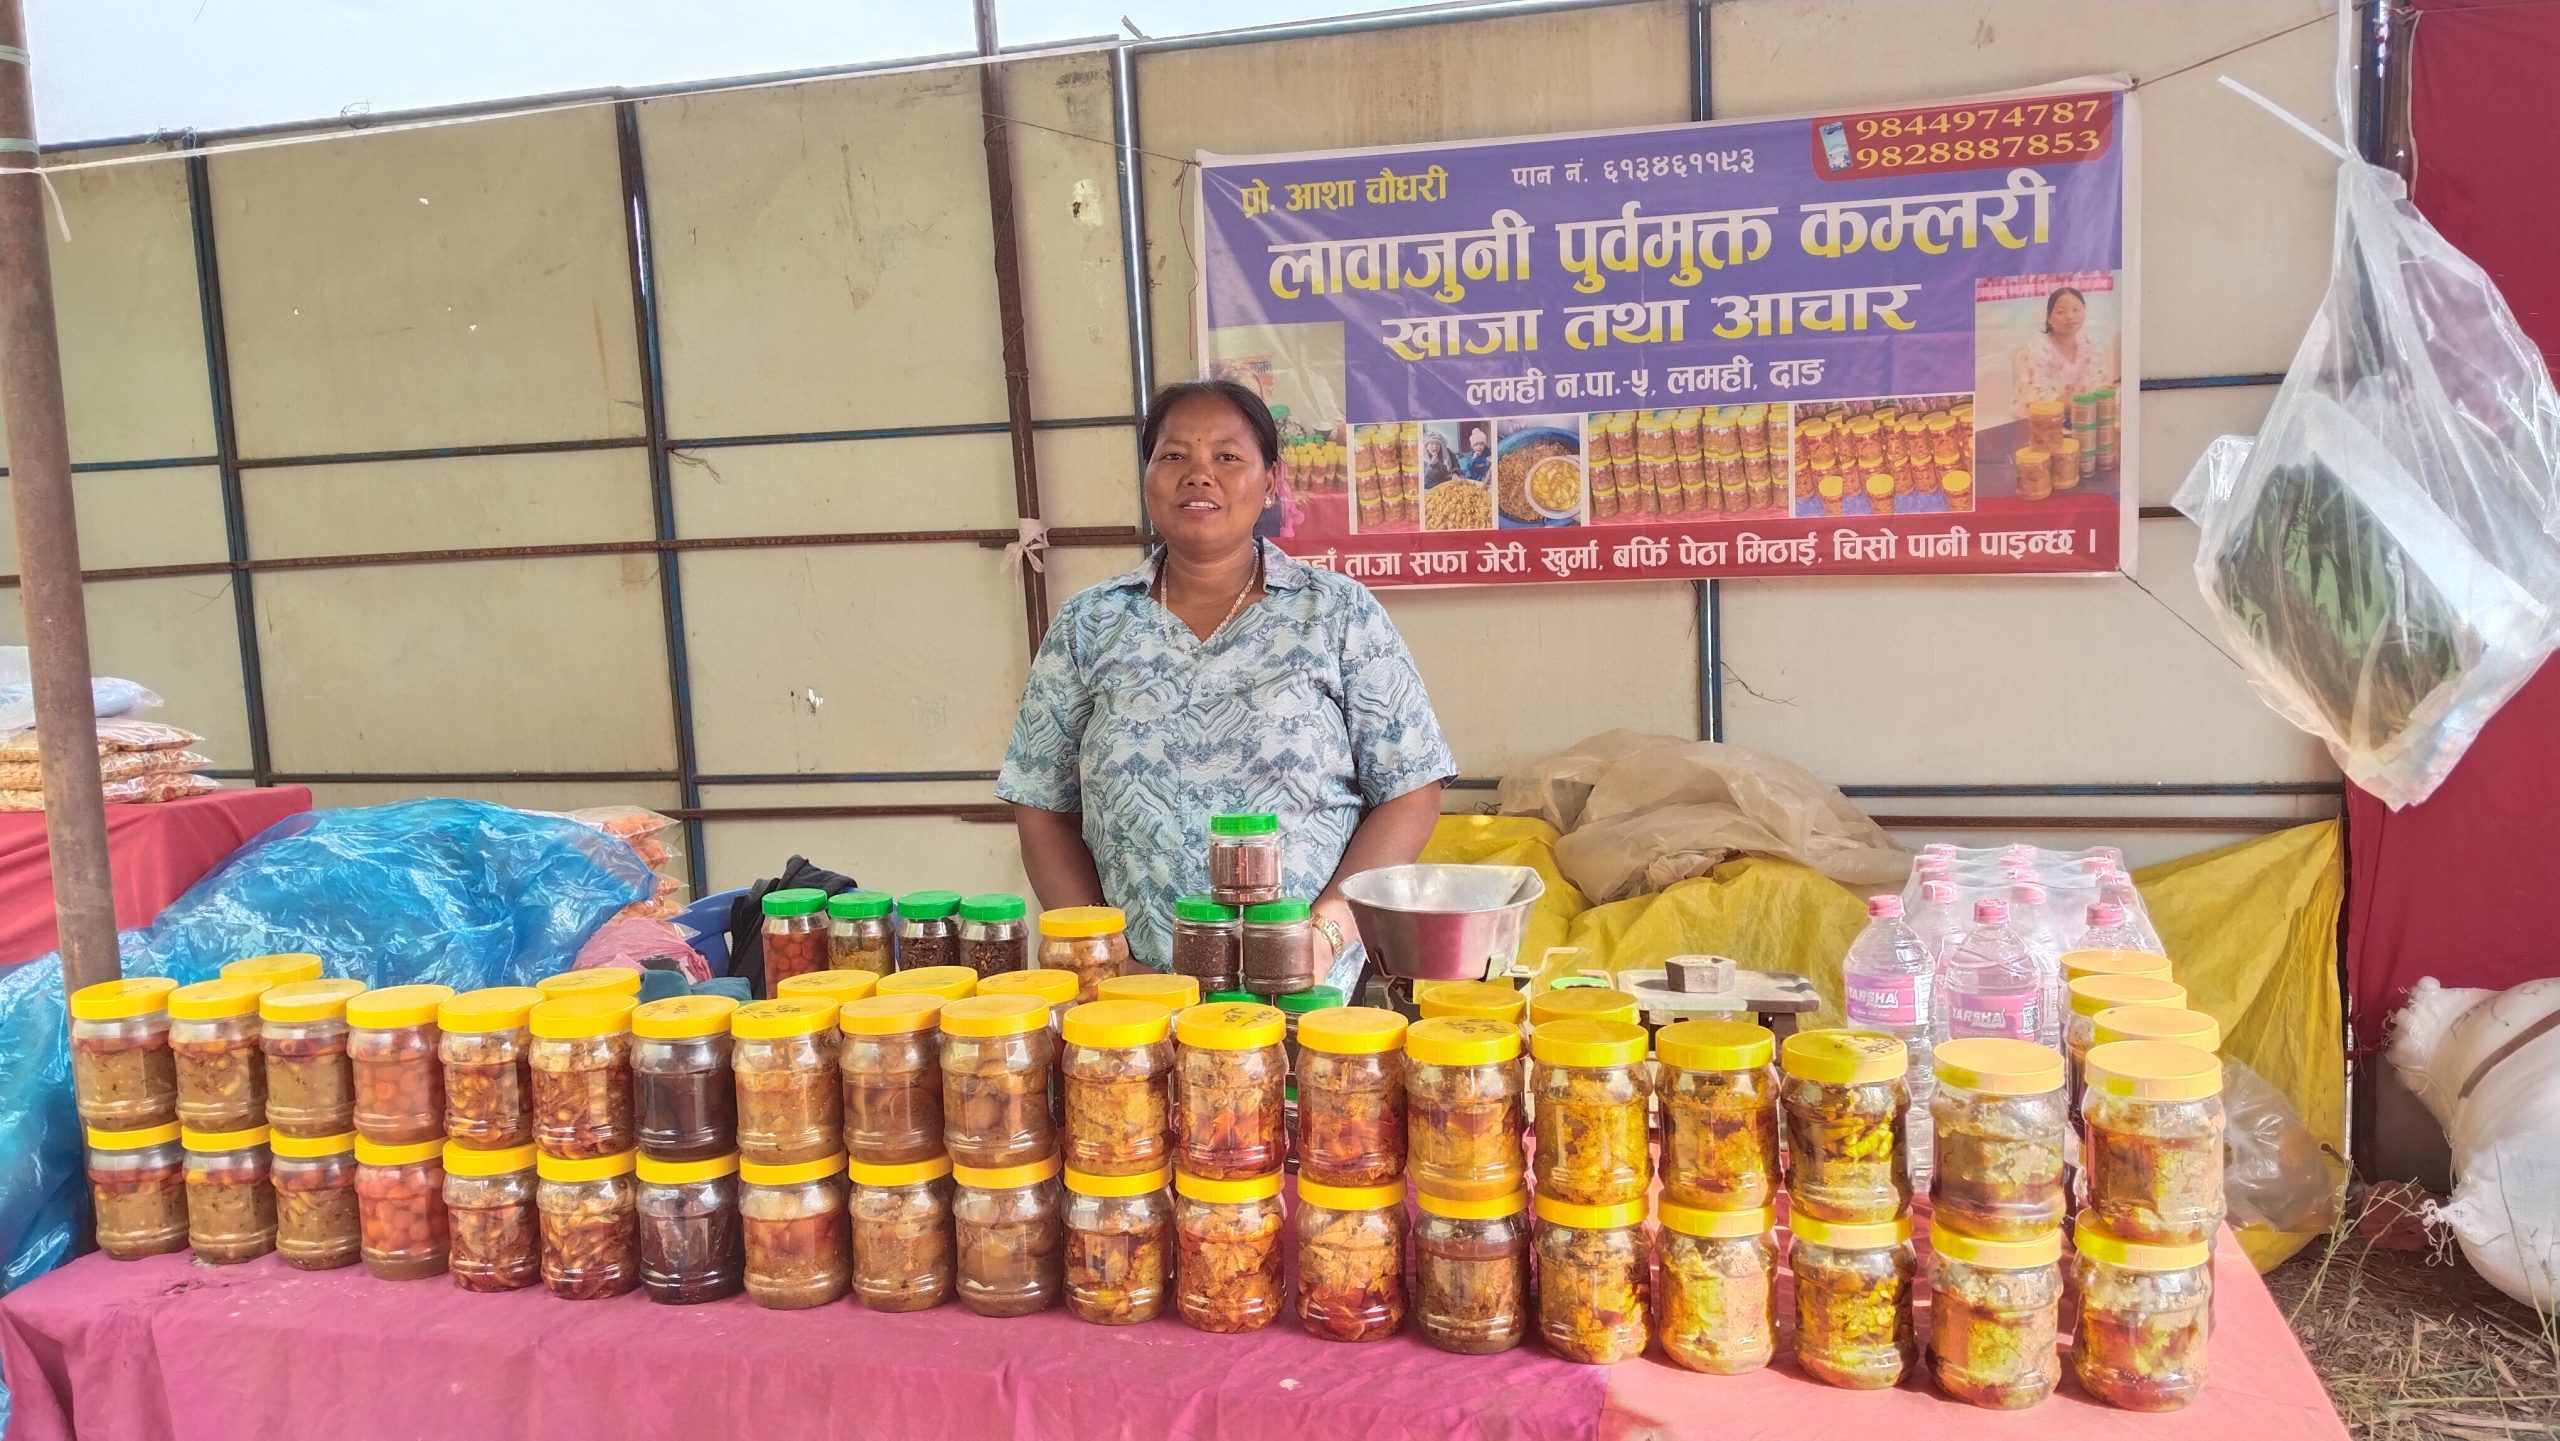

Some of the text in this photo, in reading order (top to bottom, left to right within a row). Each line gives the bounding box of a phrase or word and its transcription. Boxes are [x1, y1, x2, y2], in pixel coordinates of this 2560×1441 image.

[1856, 100, 2100, 140] 9844974787
[1511, 165, 1554, 187] पान
[1564, 158, 1588, 183] नं.
[1856, 130, 2100, 169] 9828887853
[1240, 164, 1448, 219] प्रो. आशा चौधरी
[1268, 168, 2056, 303] लावाजुनी पुर्वमुक्त कम्लरी
[1381, 309, 1543, 361] खाजा
[1563, 299, 1690, 350] तथा
[1711, 284, 1921, 339] आचार
[1465, 367, 1546, 405] लमही
[1667, 354, 1758, 393] लमही,
[1769, 359, 1825, 389] दाङ
[1345, 553, 1402, 577] ताजा
[1410, 550, 1469, 576] सफा
[1477, 542, 1531, 573] जेरी,
[1541, 540, 1604, 576] खुर्मा,
[1678, 535, 1728, 565] पेठा
[1737, 531, 1823, 566] मिठाई,
[1833, 527, 1898, 561] चिसो
[1907, 525, 1971, 557] पानी
[1979, 529, 2076, 560] पाइन्छ
